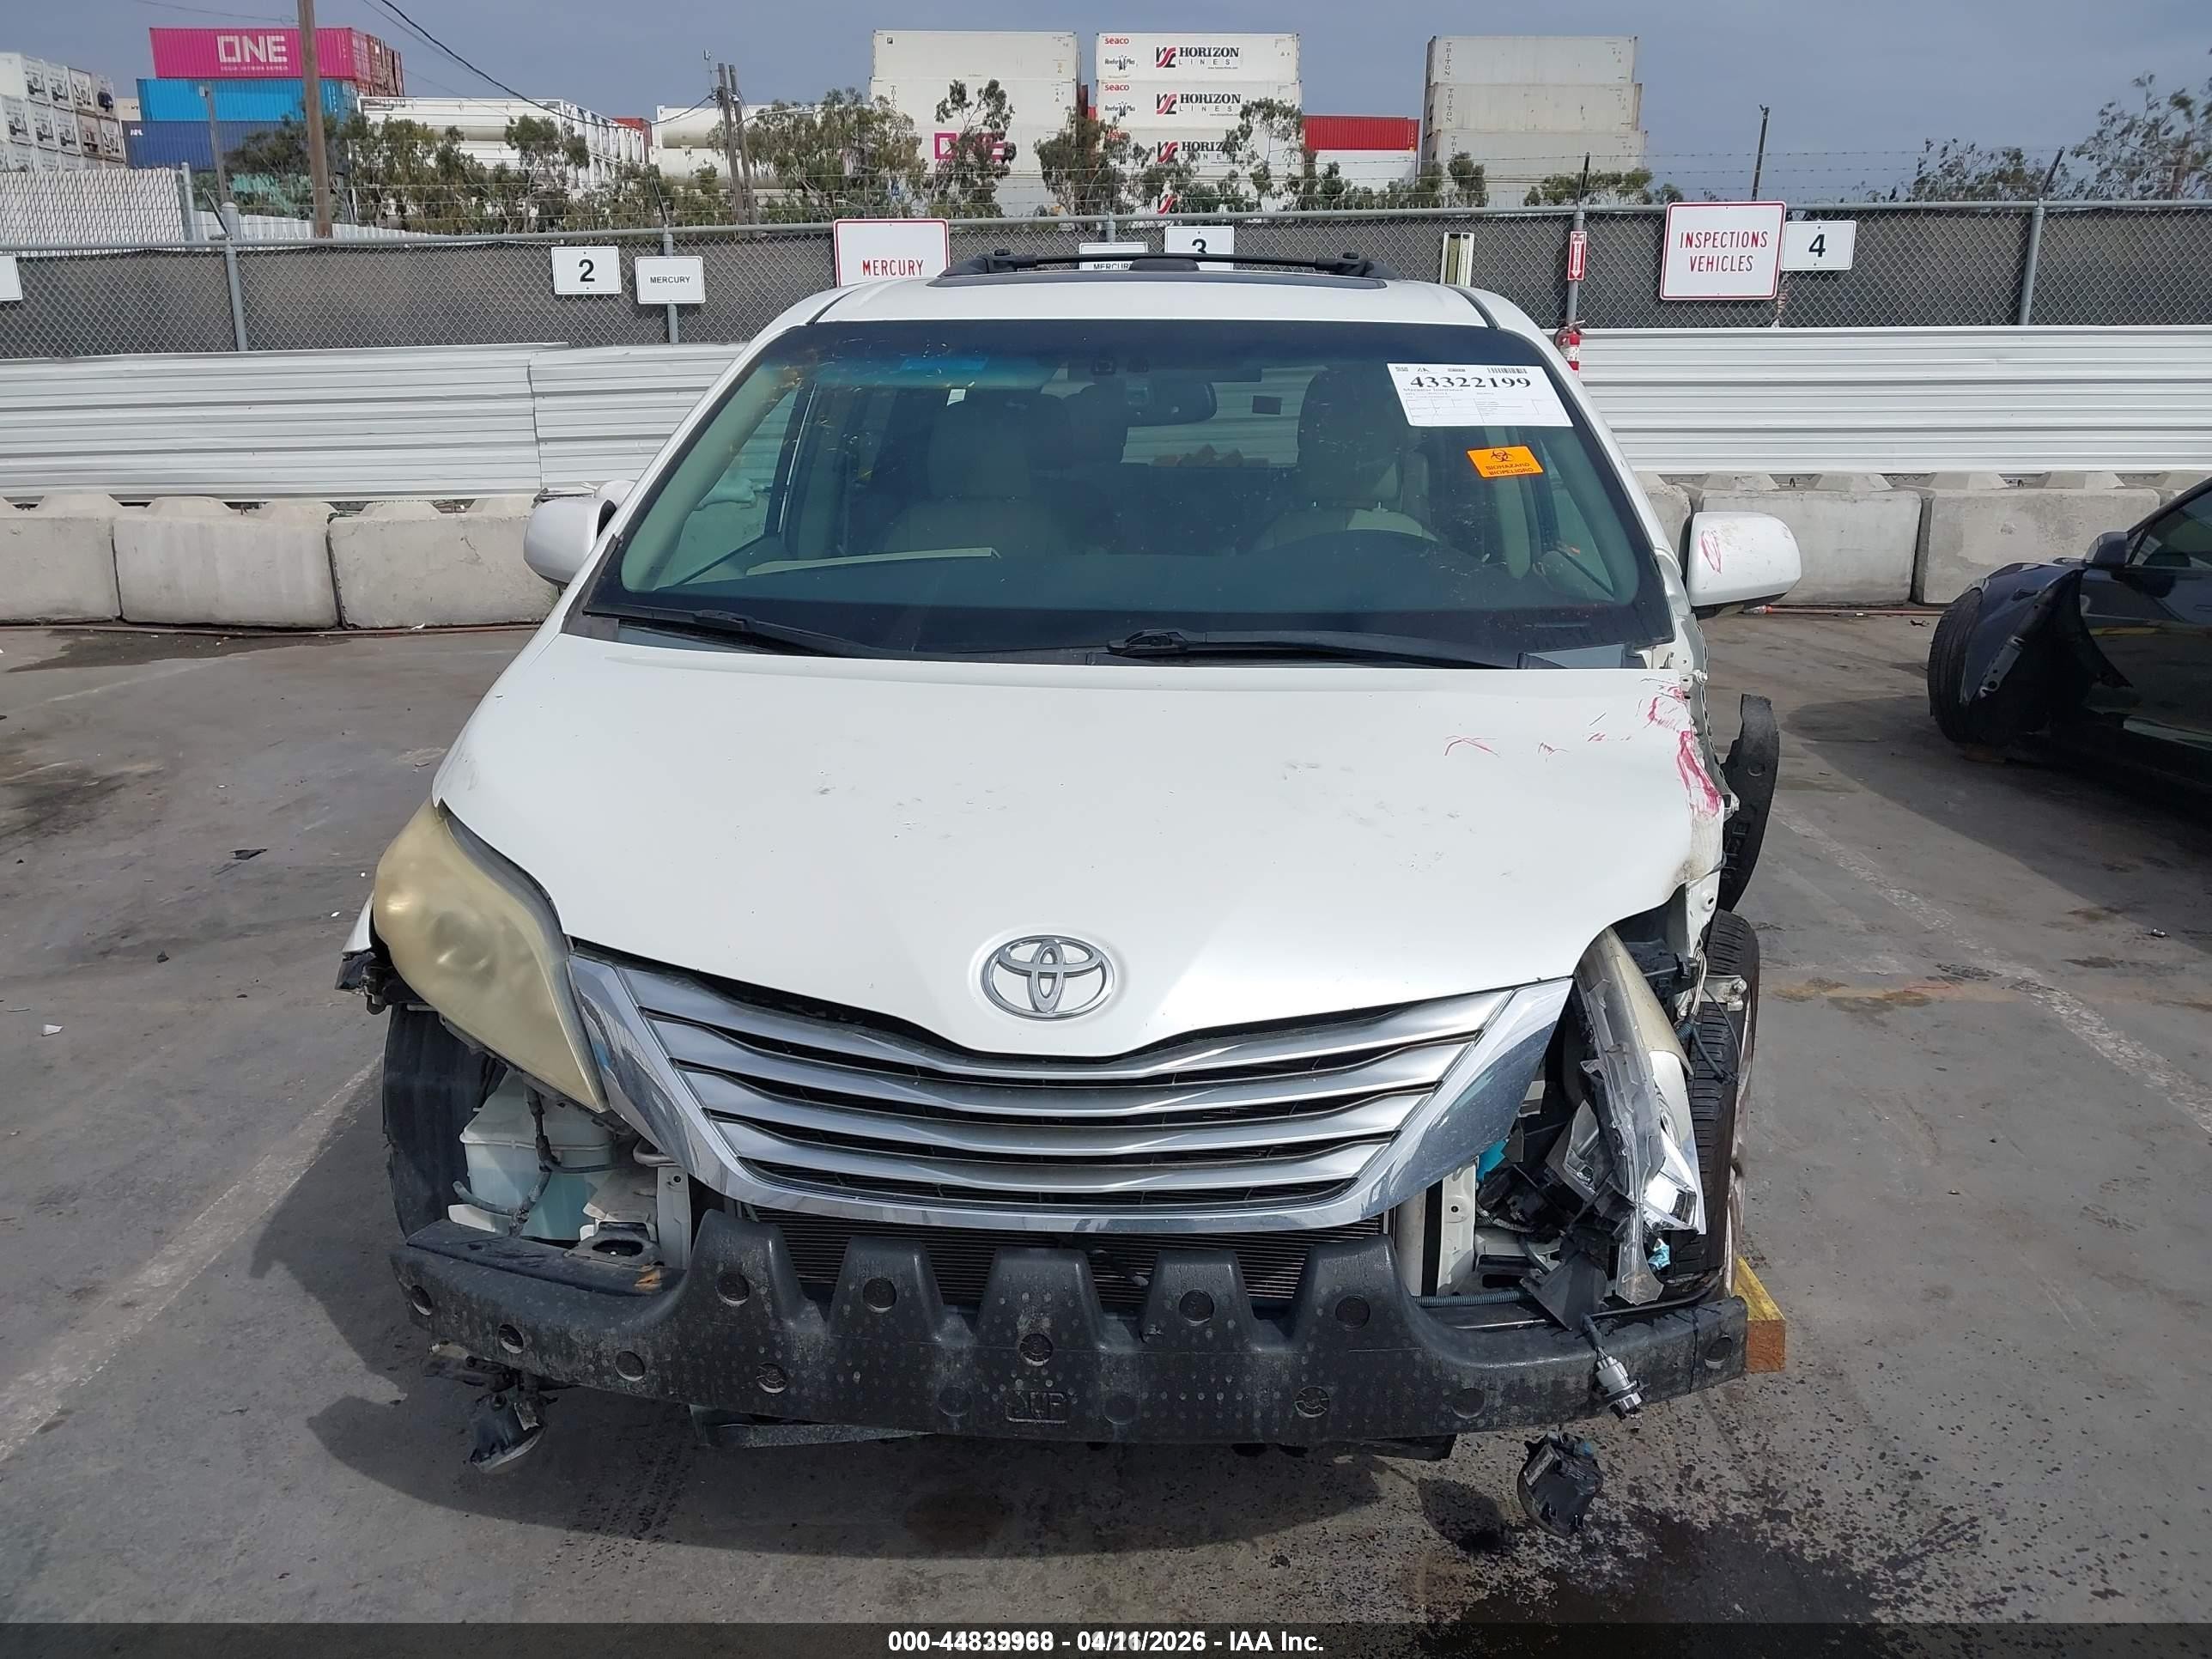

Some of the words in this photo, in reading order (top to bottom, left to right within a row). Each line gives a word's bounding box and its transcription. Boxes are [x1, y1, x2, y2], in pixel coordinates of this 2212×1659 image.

[216, 35, 288, 63] ONE
[1104, 36, 1130, 45] seaco
[1179, 46, 1241, 58] HORIZON
[1443, 42, 1453, 76] TRITON
[1180, 93, 1242, 104] HORIZON
[1446, 88, 1455, 123] TRITON
[934, 132, 1005, 160] OE
[1182, 142, 1243, 152] HORIZN
[1191, 238, 1207, 254] 3
[1680, 230, 1769, 249] INSPECTIONS
[1808, 234, 1826, 258] 4
[578, 258, 596, 283] 2
[861, 259, 925, 276] MERCURY
[1689, 255, 1754, 273] VEHICLES
[649, 276, 691, 284] MERCURY
[1410, 375, 1532, 388] 43322199
[1485, 462, 1531, 471] BIOHAZARD
